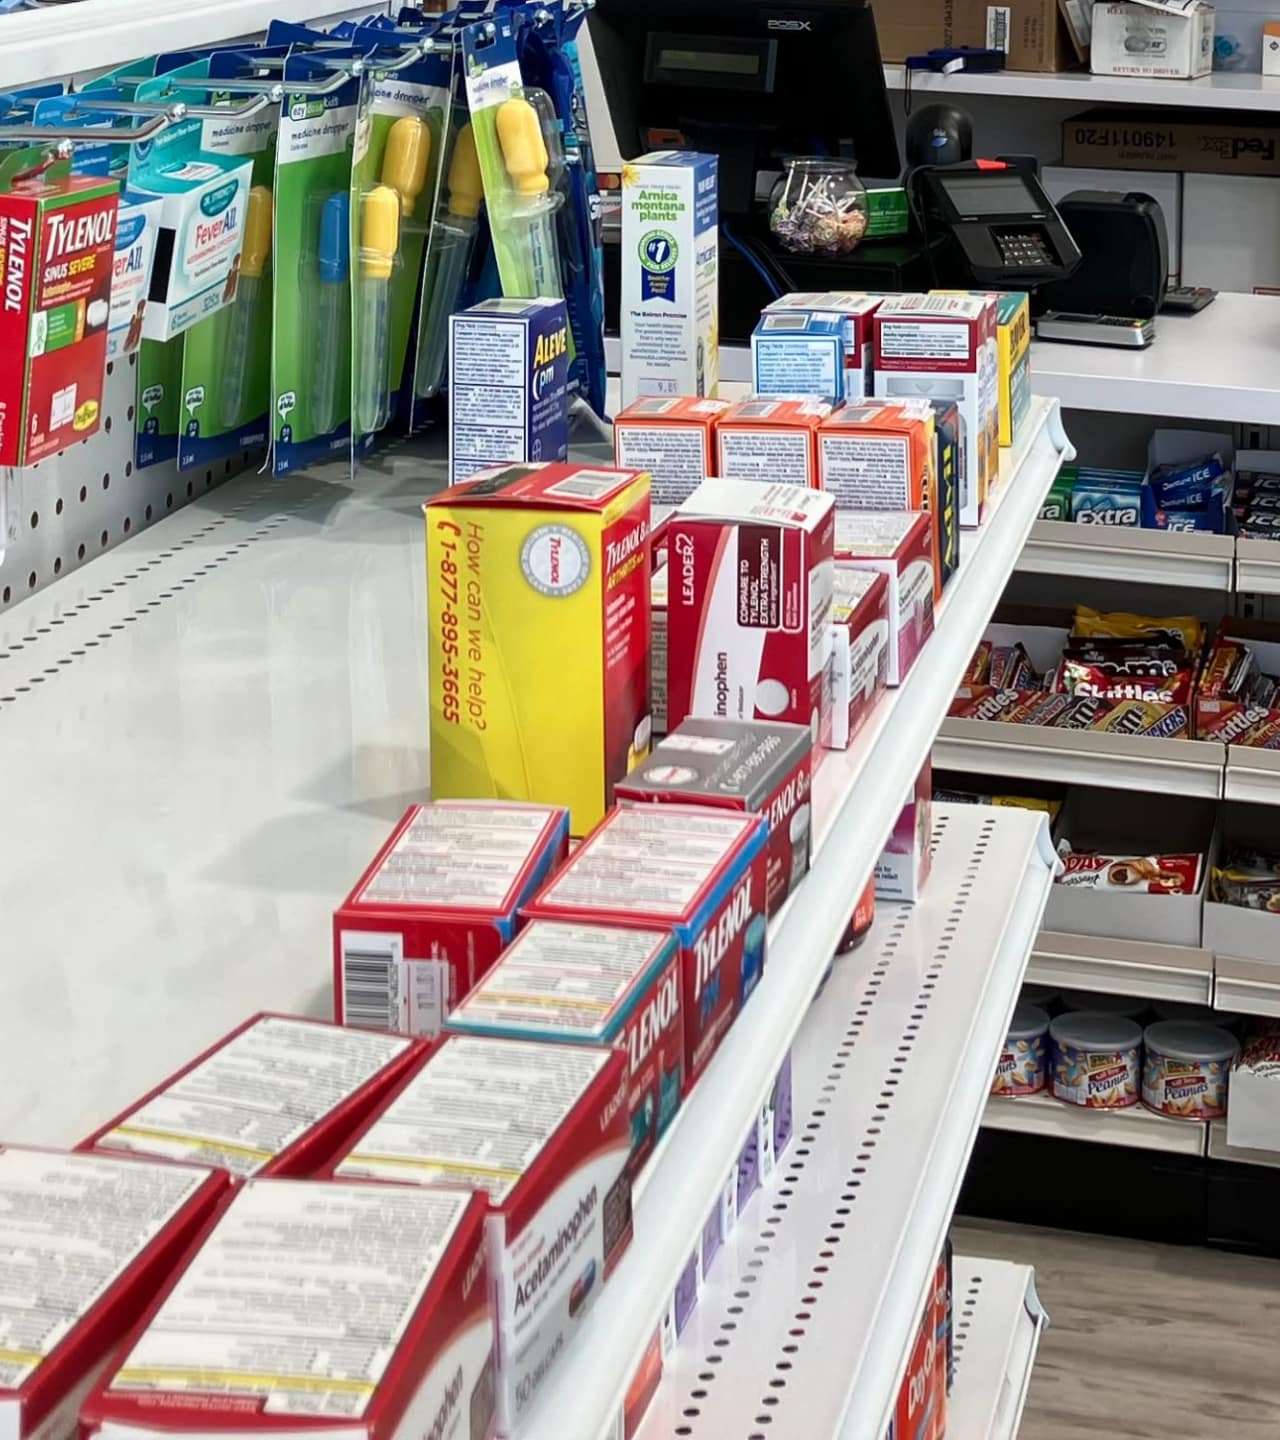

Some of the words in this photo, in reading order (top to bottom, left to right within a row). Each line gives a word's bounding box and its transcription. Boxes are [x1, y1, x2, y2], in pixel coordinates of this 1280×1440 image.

[290, 127, 320, 142] medicine
[321, 121, 349, 138] dropper
[631, 201, 686, 212] montana
[638, 190, 678, 201] Arnica
[46, 210, 114, 263] TYLENOL
[639, 212, 678, 222] plants
[5, 217, 32, 313] TYLENOL
[43, 260, 67, 283] SINUS
[68, 254, 96, 276] SEVERE
[534, 328, 567, 369] ALEVE
[1192, 467, 1210, 483] ICE
[1076, 507, 1137, 527] Extra
[1185, 492, 1203, 505] ICE
[466, 521, 484, 579] How
[549, 535, 561, 584] TYLENOL
[605, 529, 641, 576] TYLENOL
[738, 559, 750, 571] TO
[759, 538, 770, 591] STRENGTH
[682, 538, 695, 606] LEADER
[467, 580, 481, 621] can
[738, 573, 750, 625] COMPARE
[750, 577, 760, 624] TYLENOL
[759, 593, 770, 625] EXTRA
[438, 539, 460, 726] 1-877-895-3665
[467, 625, 481, 662] we
[468, 667, 486, 731] help?
[713, 651, 727, 717] inophen
[1075, 682, 1174, 707] Skittles
[694, 877, 753, 1003] TYLENOL
[1087, 1073, 1129, 1095] Peanuts
[1164, 1083, 1208, 1100] Peanuts
[512, 1184, 599, 1316] Acetaminophen
